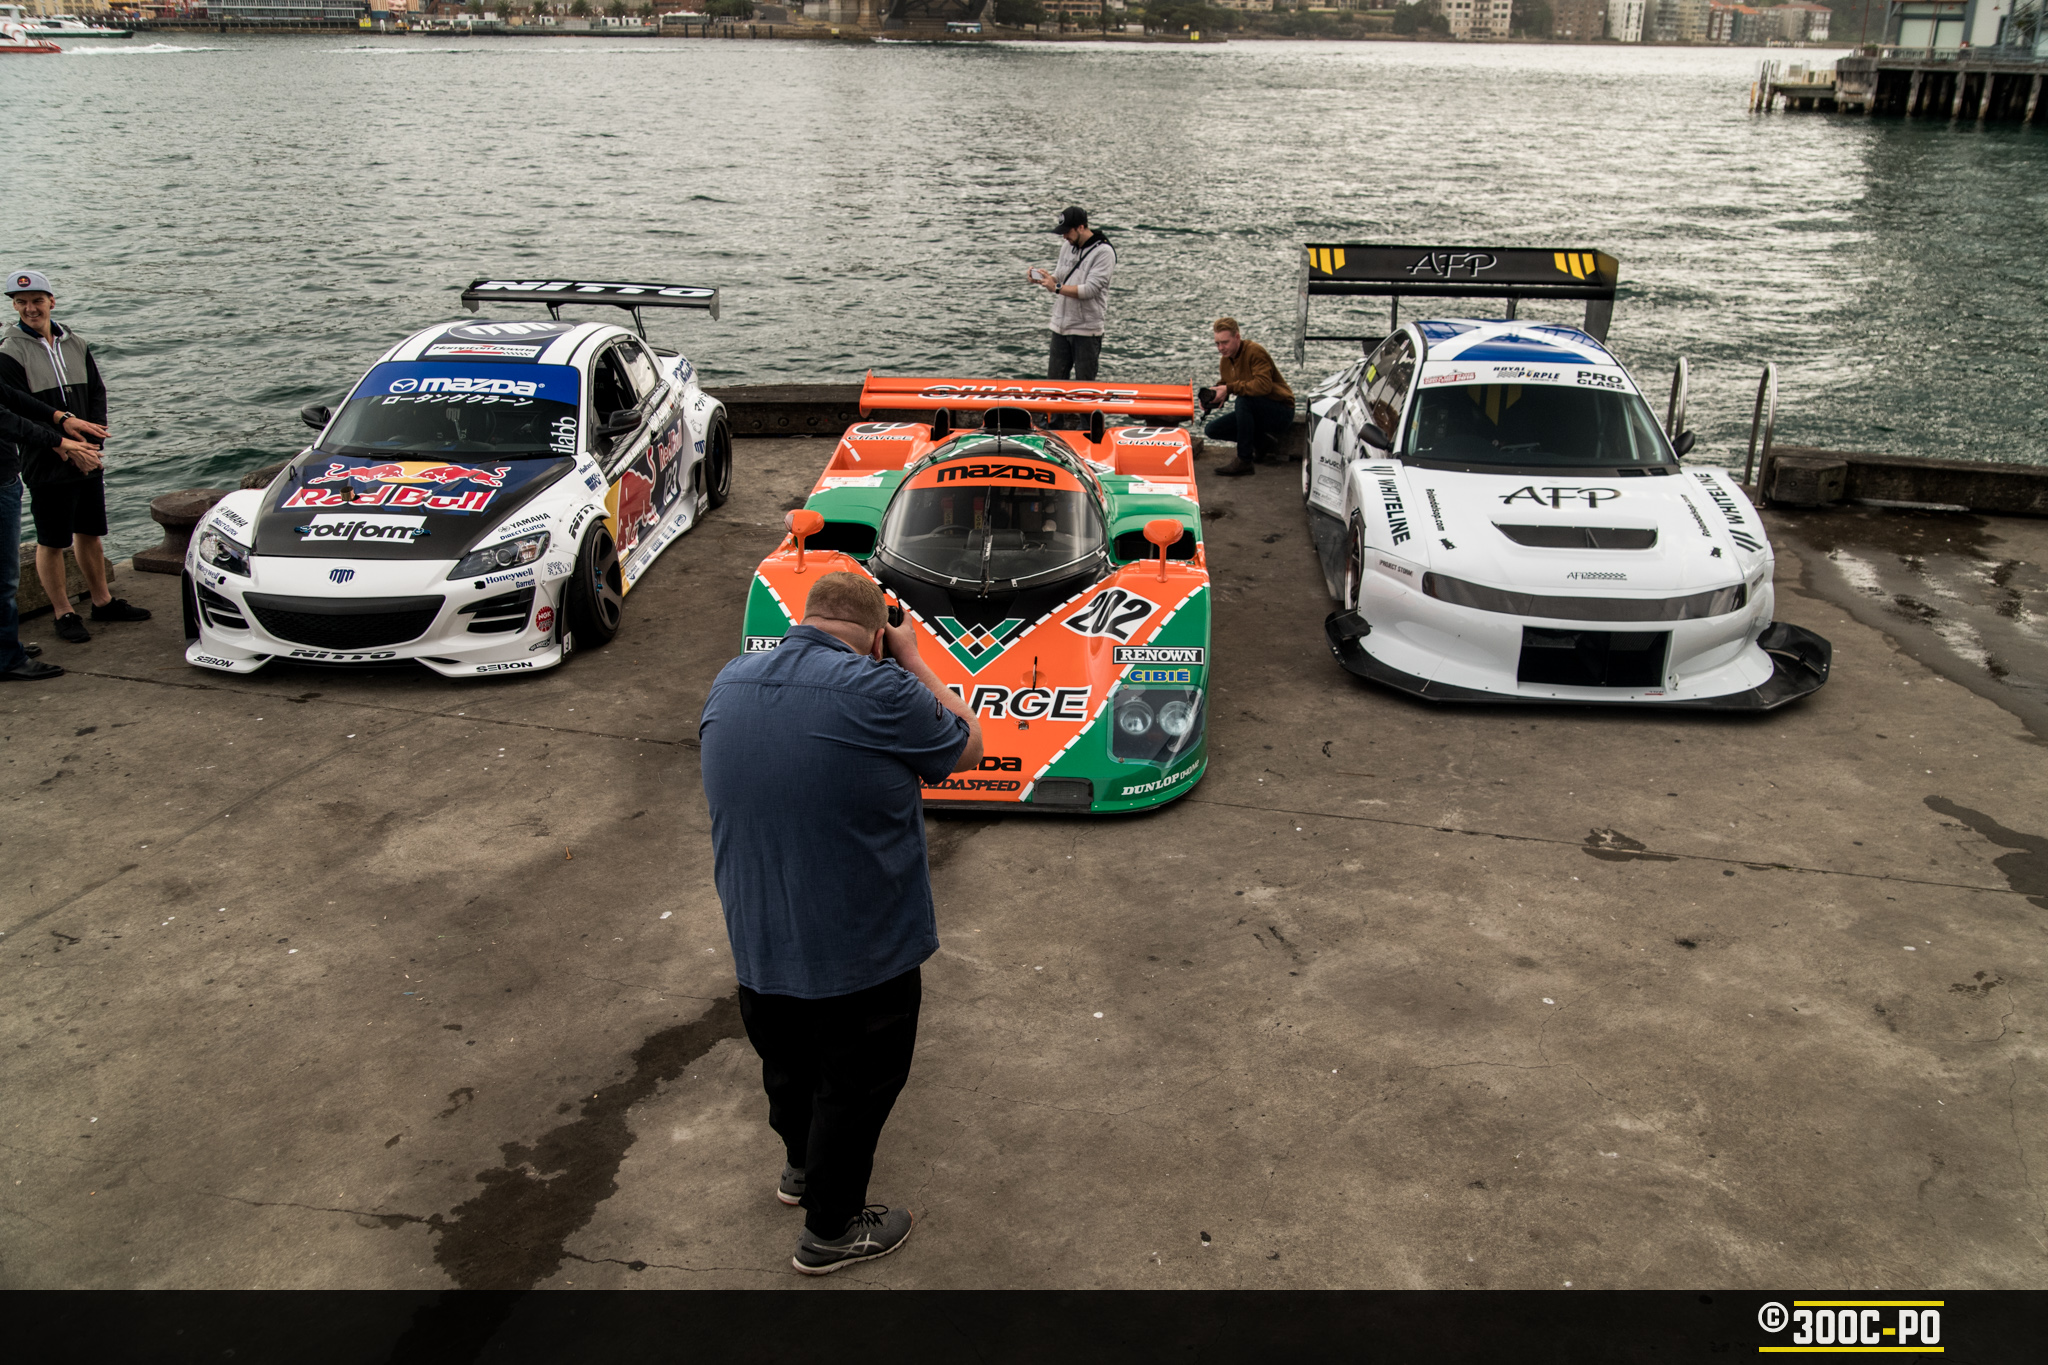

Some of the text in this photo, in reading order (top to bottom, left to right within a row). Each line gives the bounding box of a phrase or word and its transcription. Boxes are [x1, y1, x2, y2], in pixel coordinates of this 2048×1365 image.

[1406, 252, 1497, 278] AFP
[474, 280, 714, 297] NITTO
[1577, 371, 1623, 384] PRO
[1577, 379, 1626, 390] CLASS
[551, 416, 576, 454] ilabb
[1498, 485, 1621, 509] AFP
[1693, 472, 1745, 525] WHITELINE
[221, 508, 249, 528] YAMAHA
[510, 512, 552, 529] YAMAHA
[1378, 479, 1411, 546] WHITELINE
[308, 520, 420, 542] rotiform
[499, 523, 546, 541] DIRECT CLUTCH
[486, 568, 534, 585] Honeywell
[515, 578, 536, 589] Garrett
[538, 611, 552, 621] NGK
[1066, 590, 1152, 638] 202
[193, 656, 234, 668] SEBON
[289, 649, 397, 660] NITTO
[1120, 649, 1198, 662] RENOWN
[476, 661, 533, 673] SEBON
[1121, 772, 1180, 796] DUNLOP
